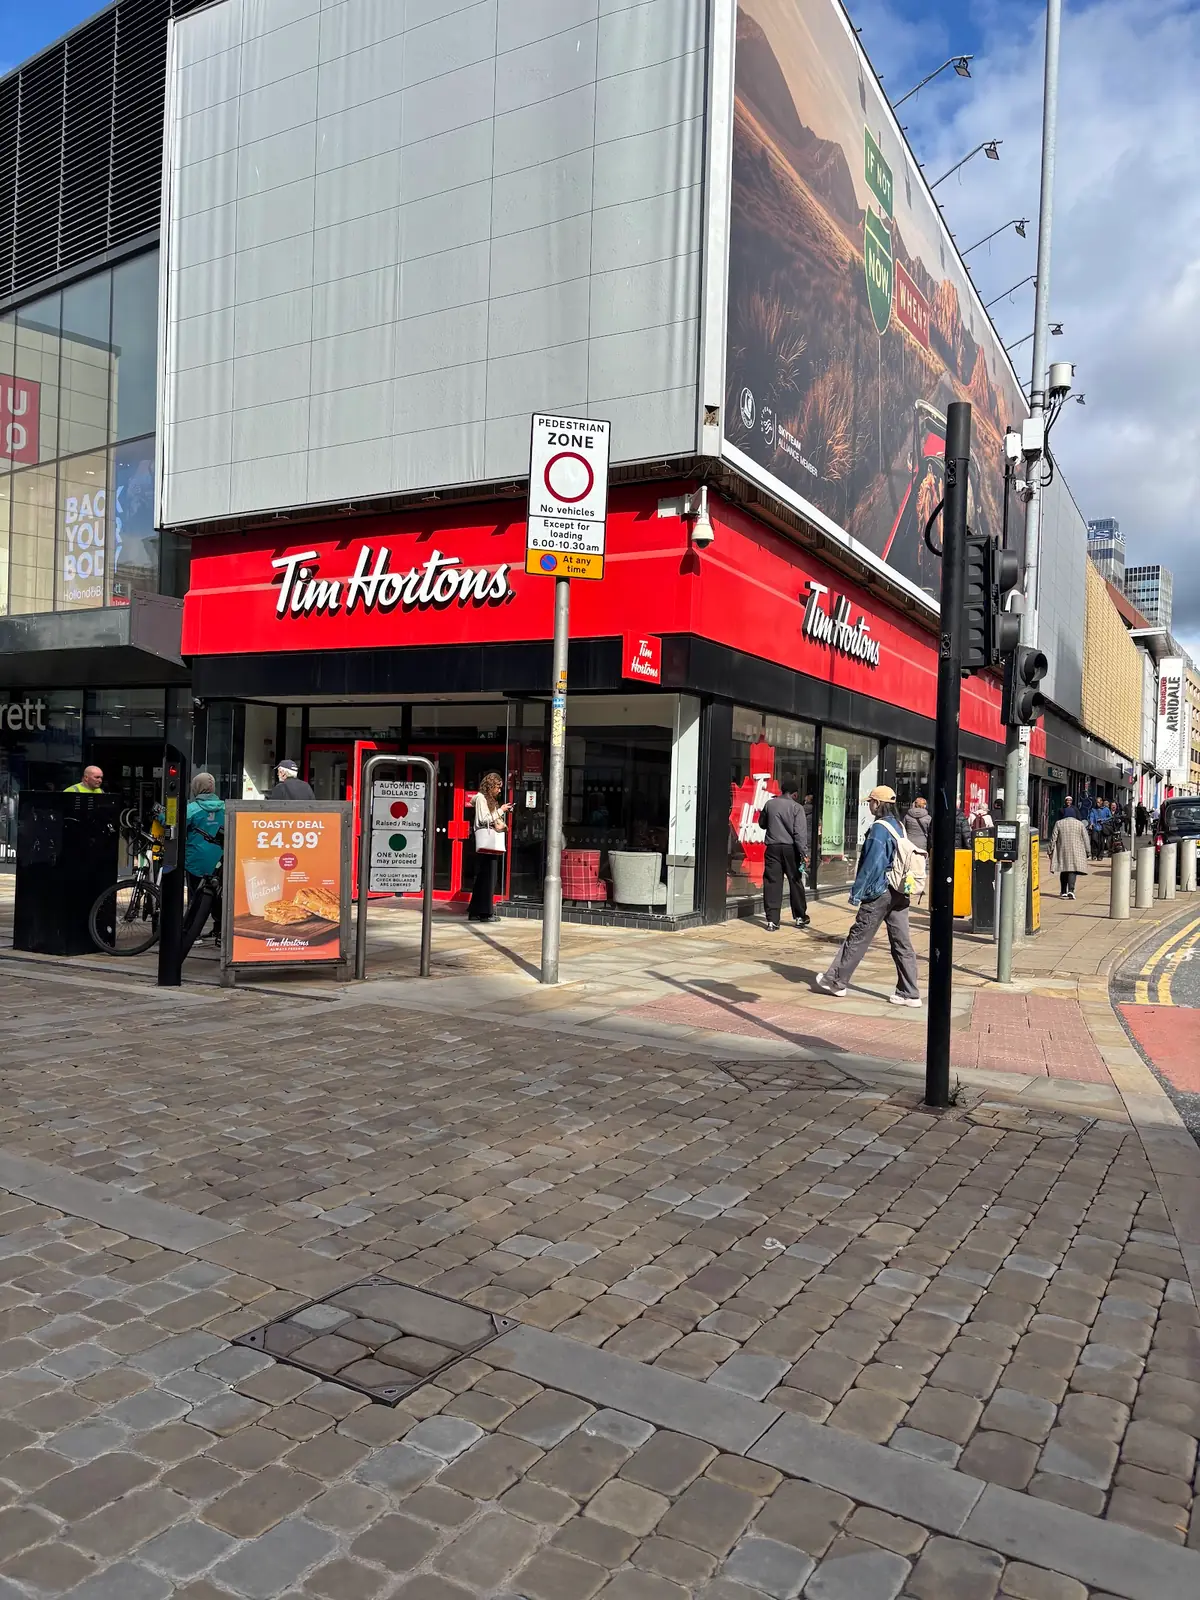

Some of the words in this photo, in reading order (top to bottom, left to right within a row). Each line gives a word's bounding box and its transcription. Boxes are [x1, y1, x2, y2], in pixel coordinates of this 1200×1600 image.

[867, 147, 874, 174] IF
[876, 166, 892, 201] NOT
[868, 250, 890, 304] NOW,
[900, 279, 928, 334] WHEN?
[538, 418, 604, 432] PEDESTRIAN
[548, 432, 594, 448] ZONE
[778, 424, 802, 451] SKYTEAM
[778, 438, 800, 462] ALLIANCE
[800, 456, 818, 477] MEMBER
[540, 504, 554, 513] No
[557, 506, 595, 517] vehicles
[543, 520, 576, 531] Except
[577, 522, 590, 531] for
[550, 530, 583, 541] loading
[563, 555, 574, 564] At
[576, 558, 592, 566] any
[567, 565, 586, 574] time
[271, 550, 342, 613] Tim
[346, 545, 510, 608] Hortons
[806, 581, 834, 645] Tim
[834, 594, 880, 665] Hortons
[639, 640, 652, 658] Tim
[631, 656, 658, 677] Hortons
[1166, 676, 1180, 732] ARNDALE
[252, 820, 294, 829] TOASTY
[296, 820, 325, 829] DEAL
[266, 938, 279, 947] Tim
[280, 937, 309, 946] Hortons
